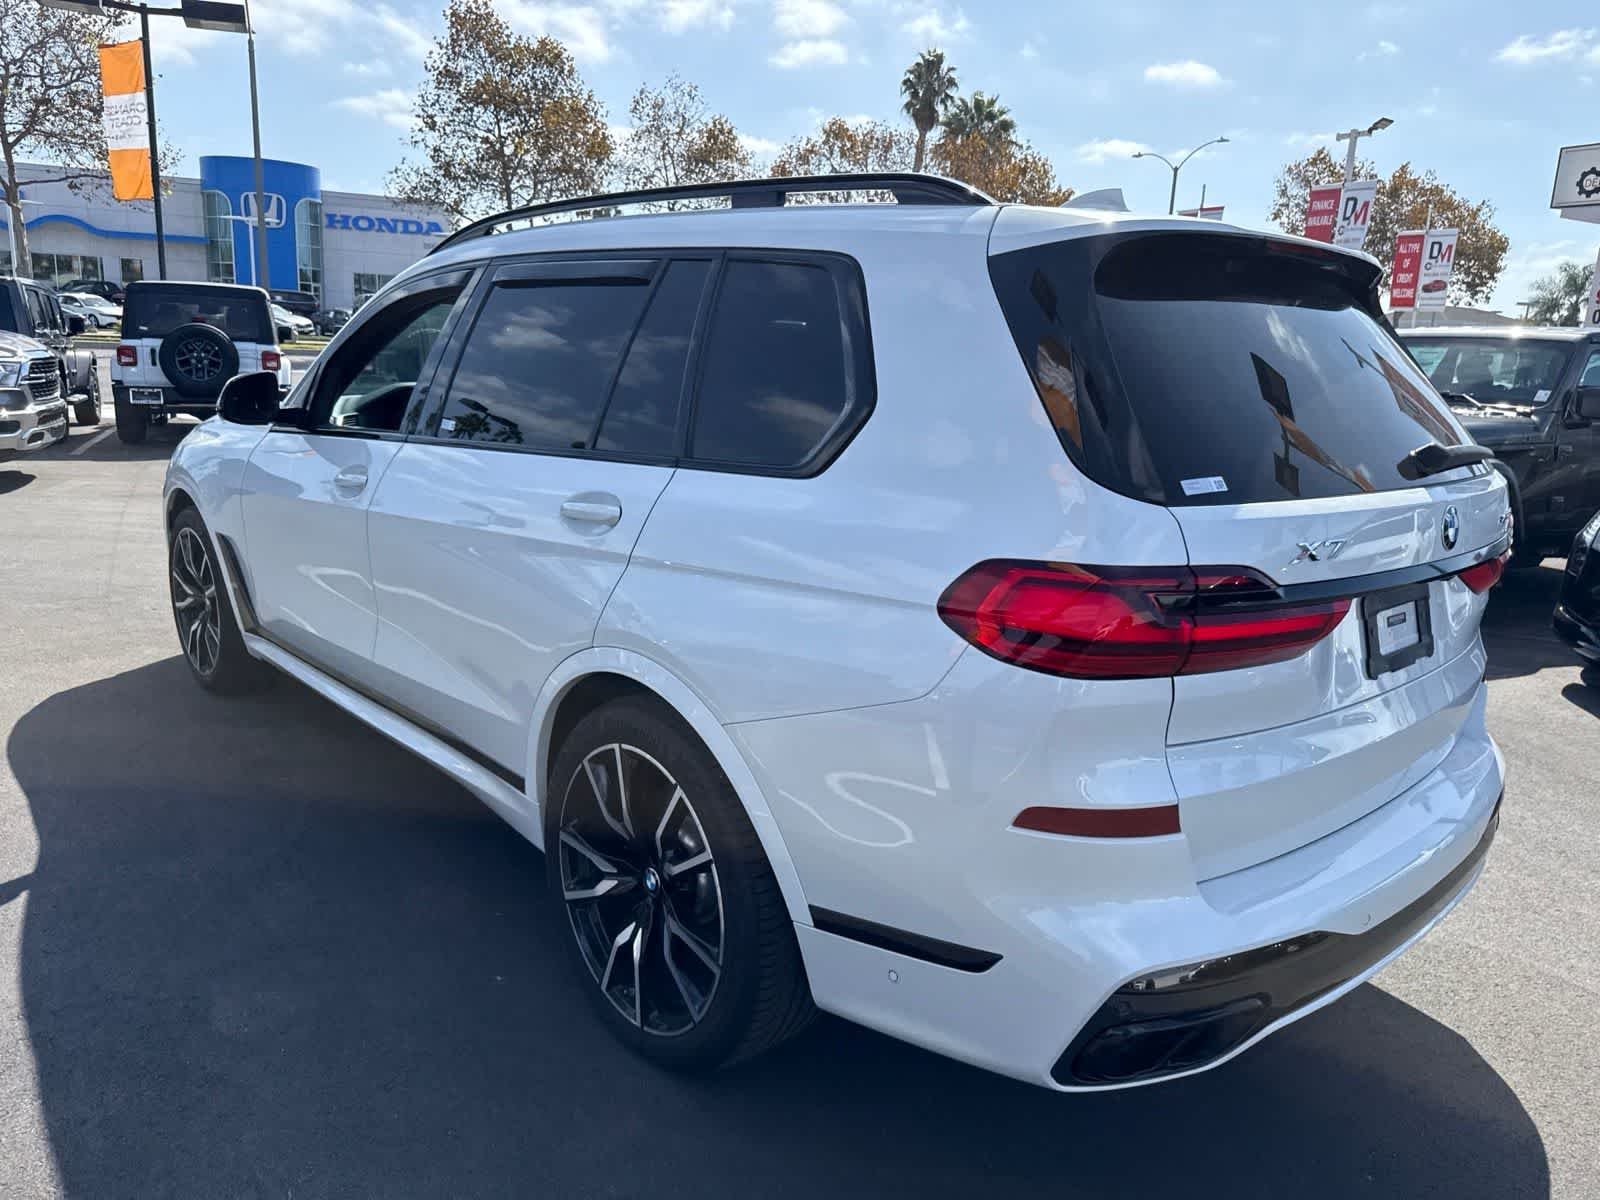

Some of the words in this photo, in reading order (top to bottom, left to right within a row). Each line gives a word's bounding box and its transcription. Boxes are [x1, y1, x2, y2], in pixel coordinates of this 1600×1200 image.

[1585, 177, 1600, 188] DE
[325, 213, 444, 235] HONDA
[1288, 539, 1347, 565] X7
